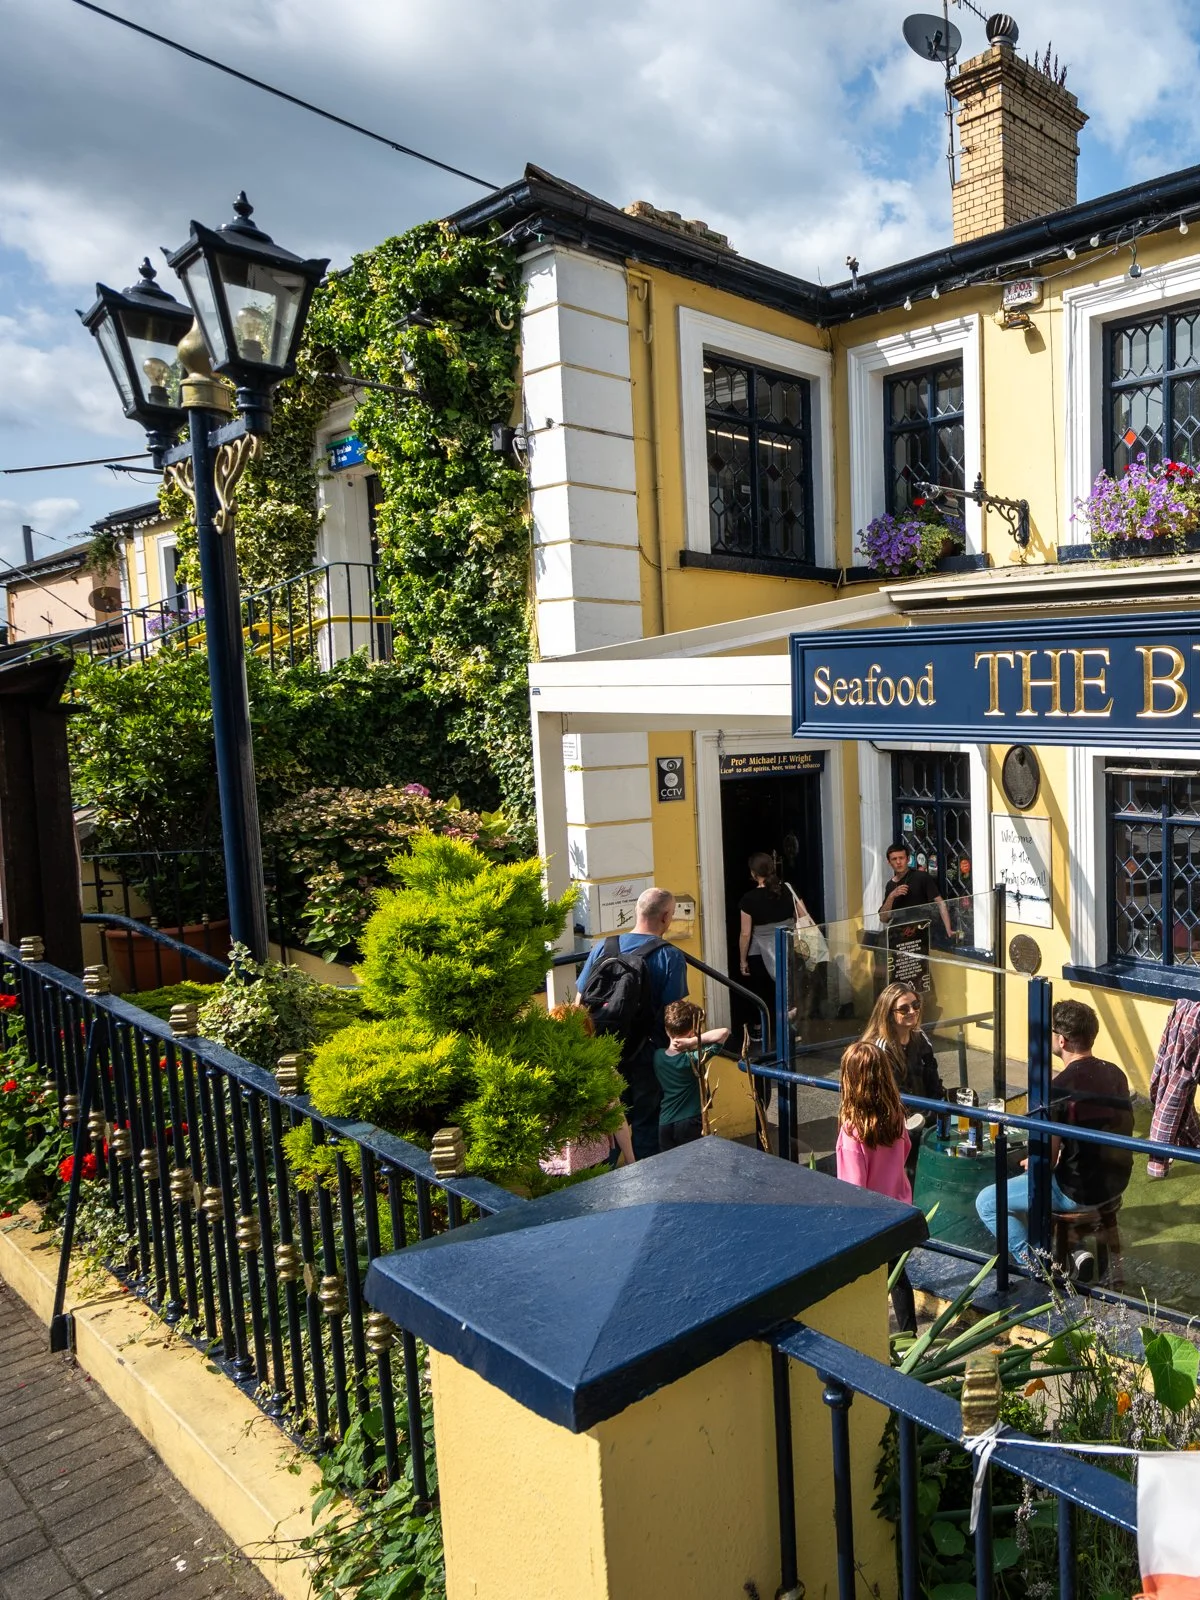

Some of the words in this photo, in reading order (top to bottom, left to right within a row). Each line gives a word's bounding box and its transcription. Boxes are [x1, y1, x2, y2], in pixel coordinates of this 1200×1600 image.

[813, 663, 936, 707] Seafood
[973, 648, 1114, 717] THE
[749, 755, 776, 765] Michael
[789, 754, 812, 764] Wright
[661, 788, 682, 796] CCTV
